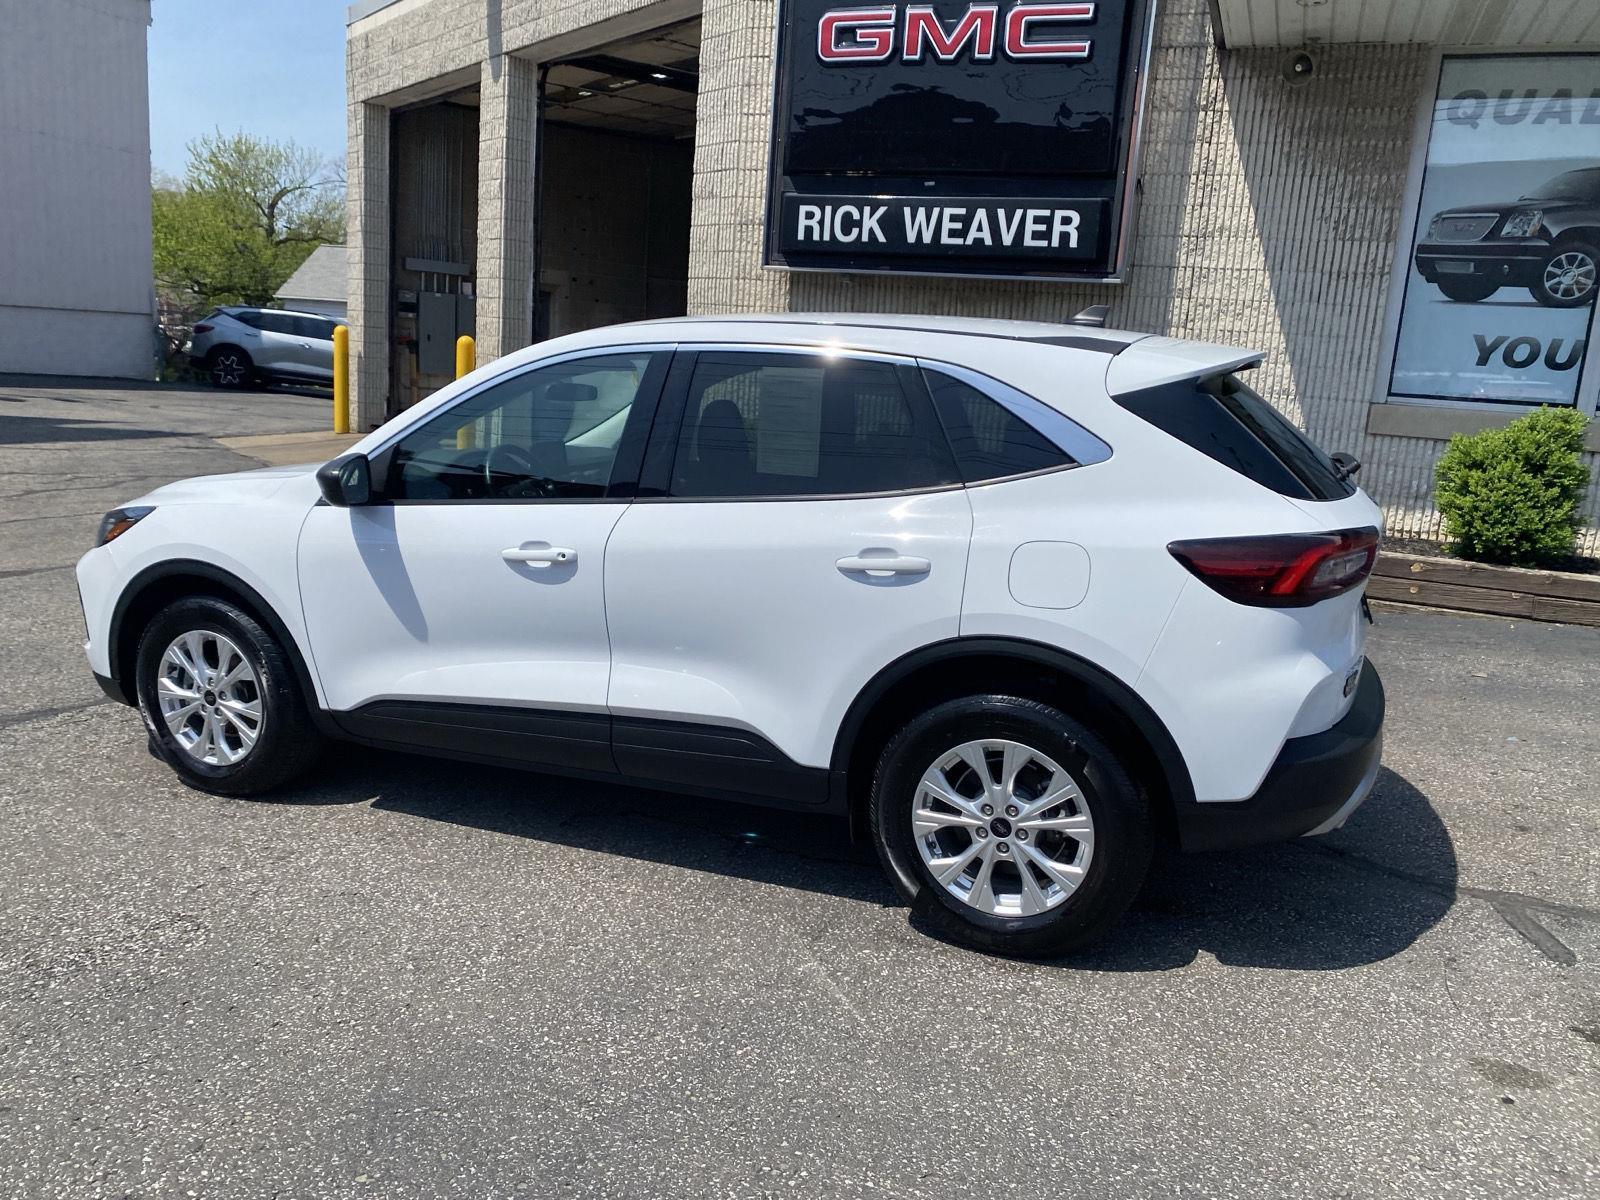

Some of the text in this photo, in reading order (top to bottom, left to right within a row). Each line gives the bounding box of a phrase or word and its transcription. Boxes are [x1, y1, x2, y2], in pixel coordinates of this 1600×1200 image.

[817, 2, 1095, 62] GMC
[797, 205, 1081, 248] RICK WEAVER
[1473, 334, 1585, 371] YOU
